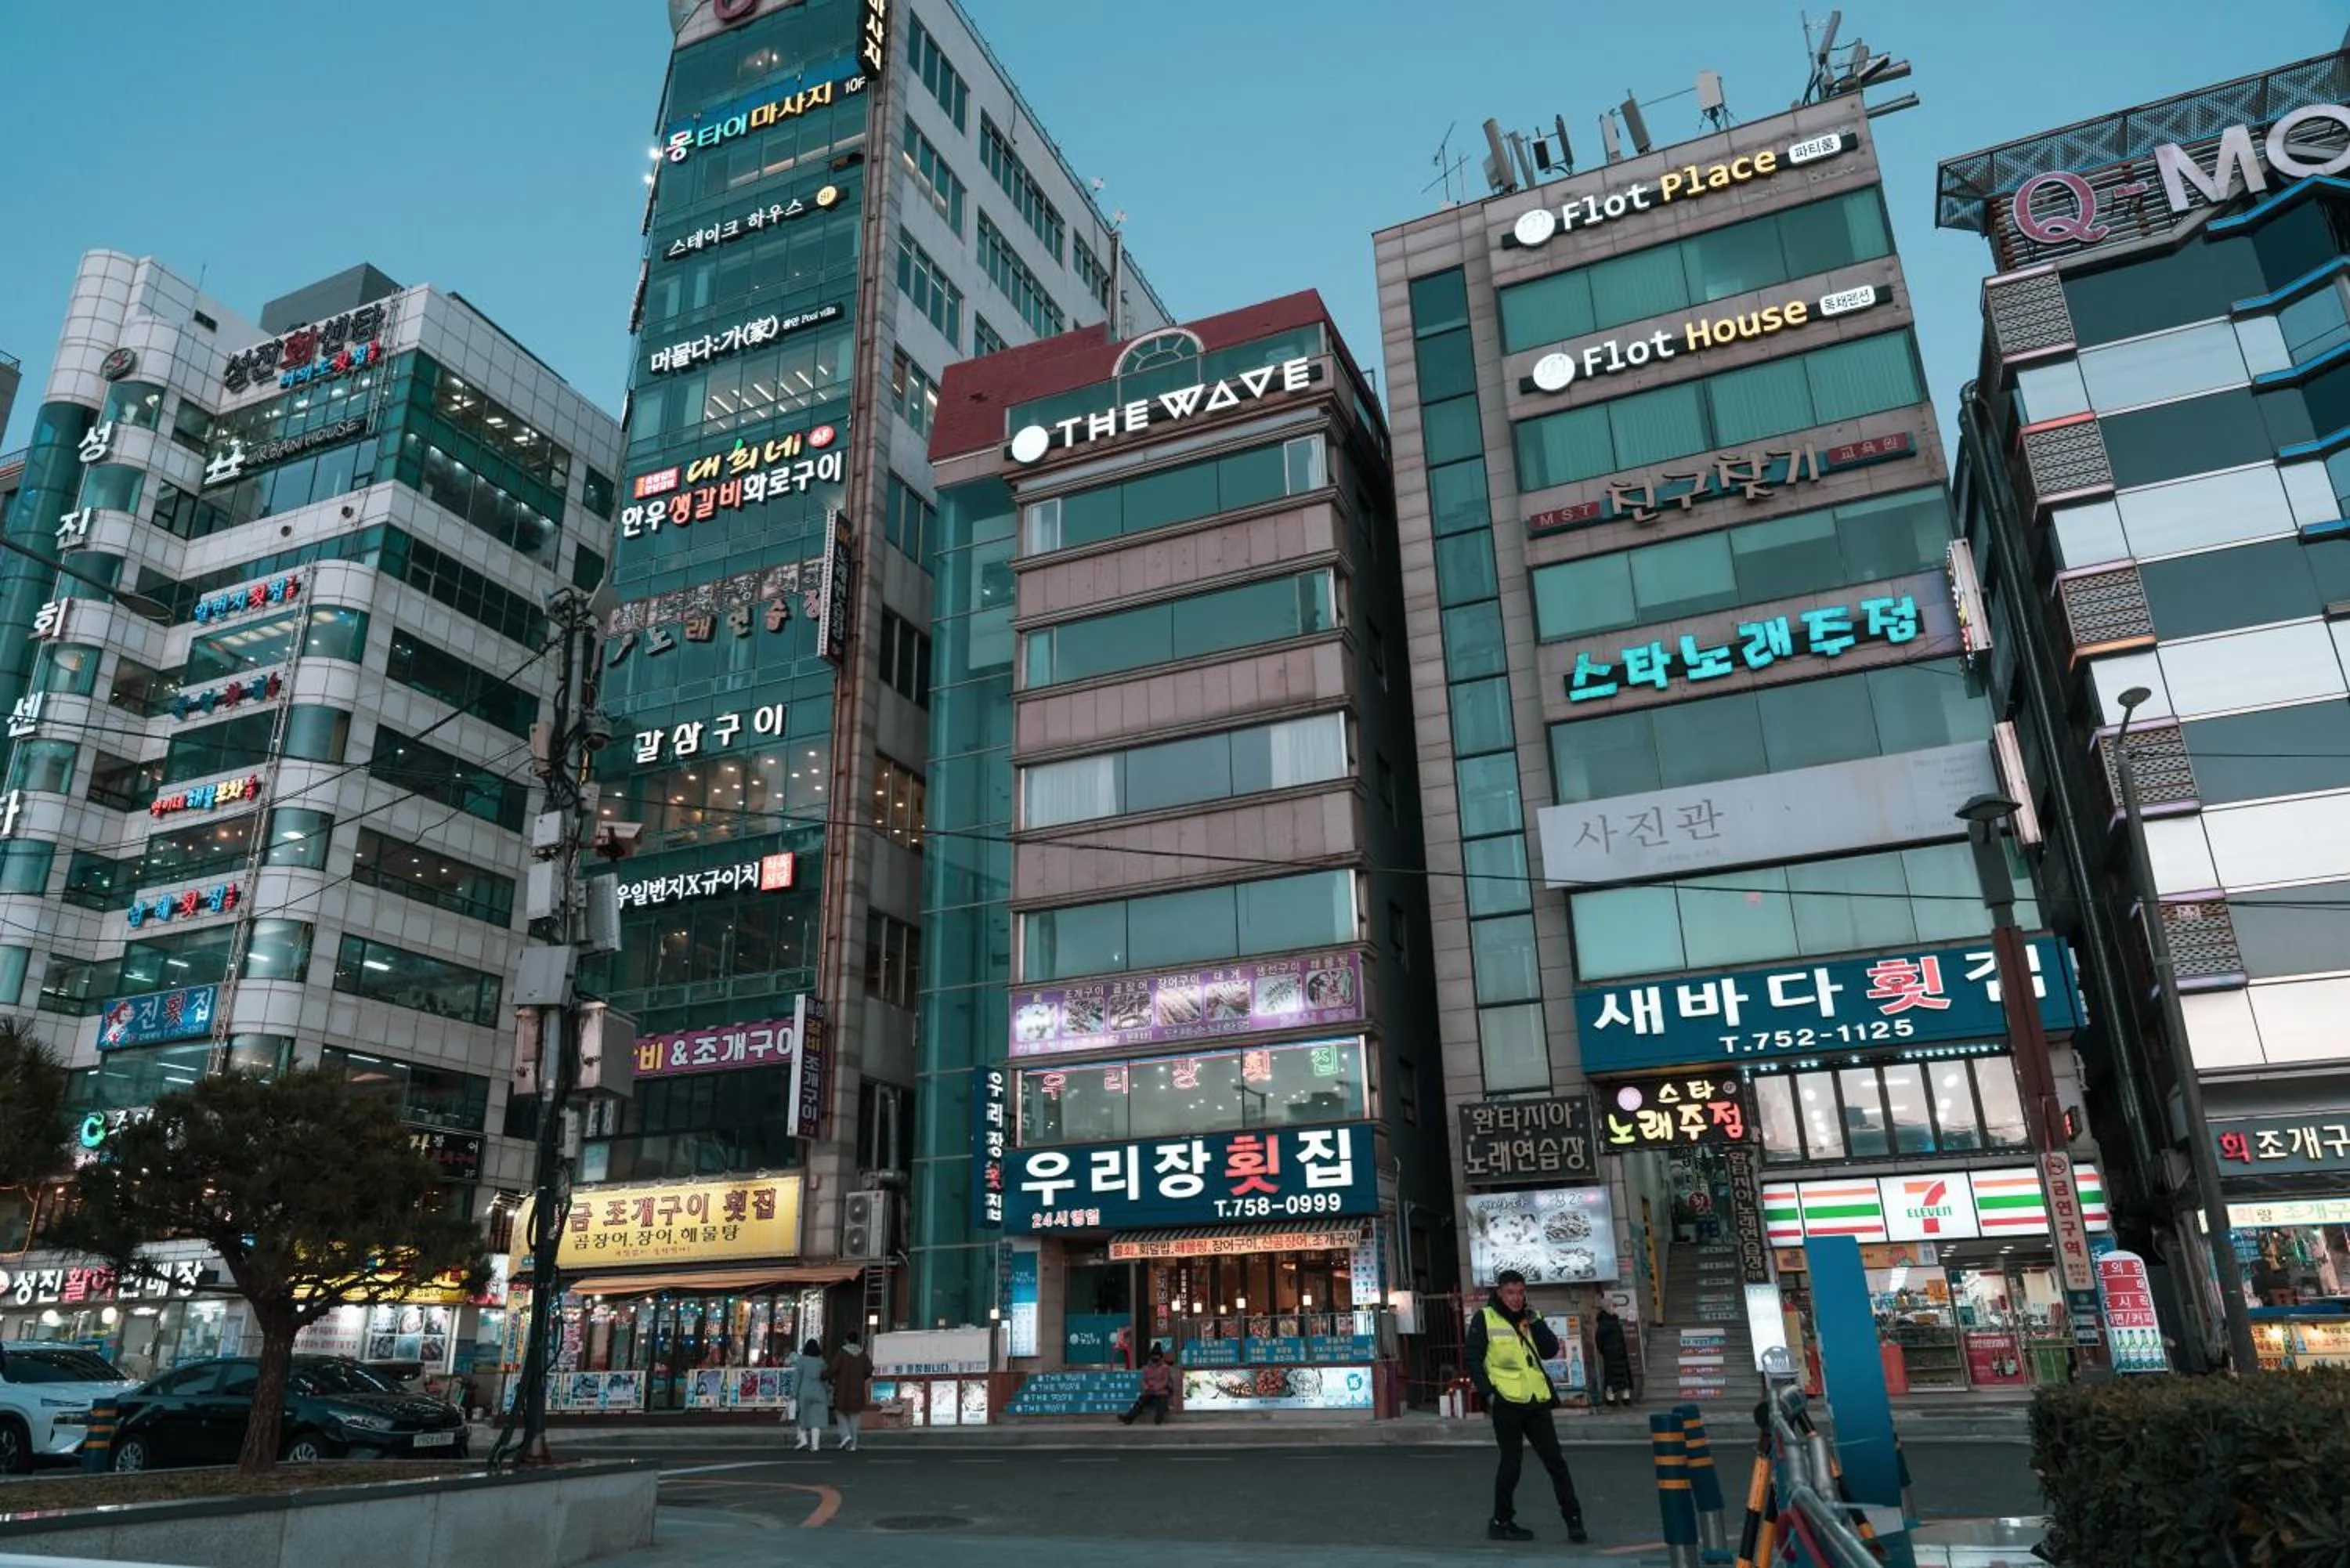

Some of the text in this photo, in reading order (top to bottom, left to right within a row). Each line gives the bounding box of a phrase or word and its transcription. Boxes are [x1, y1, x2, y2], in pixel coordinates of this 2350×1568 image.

[666, 77, 866, 162] 몽타이 마사지 10F
[1562, 137, 1835, 230] Flot Place 파티룸
[668, 199, 804, 256] 스테이크 하우스
[1584, 330, 1675, 378] Flot
[1685, 299, 1808, 351] House
[1056, 357, 1310, 449] THE WAVE
[686, 432, 801, 482] 대희네
[1539, 435, 1899, 527] MST 친구찾기 교육원
[1568, 596, 1918, 702] 스타노래주점
[634, 703, 784, 764] 갈삼구이
[1573, 799, 1724, 855] 사진관
[1658, 1080, 1716, 1104] 스타
[1607, 1102, 1744, 1144] 노래주점
[1021, 1129, 1354, 1207] 우리장횟집
[1466, 1136, 1585, 1174] 노래연습장
[603, 1192, 710, 1228] 조개구이
[723, 1186, 777, 1223] 횟집
[1032, 1209, 1101, 1229] 24시영업
[1214, 1194, 1342, 1219] T.758-0999
